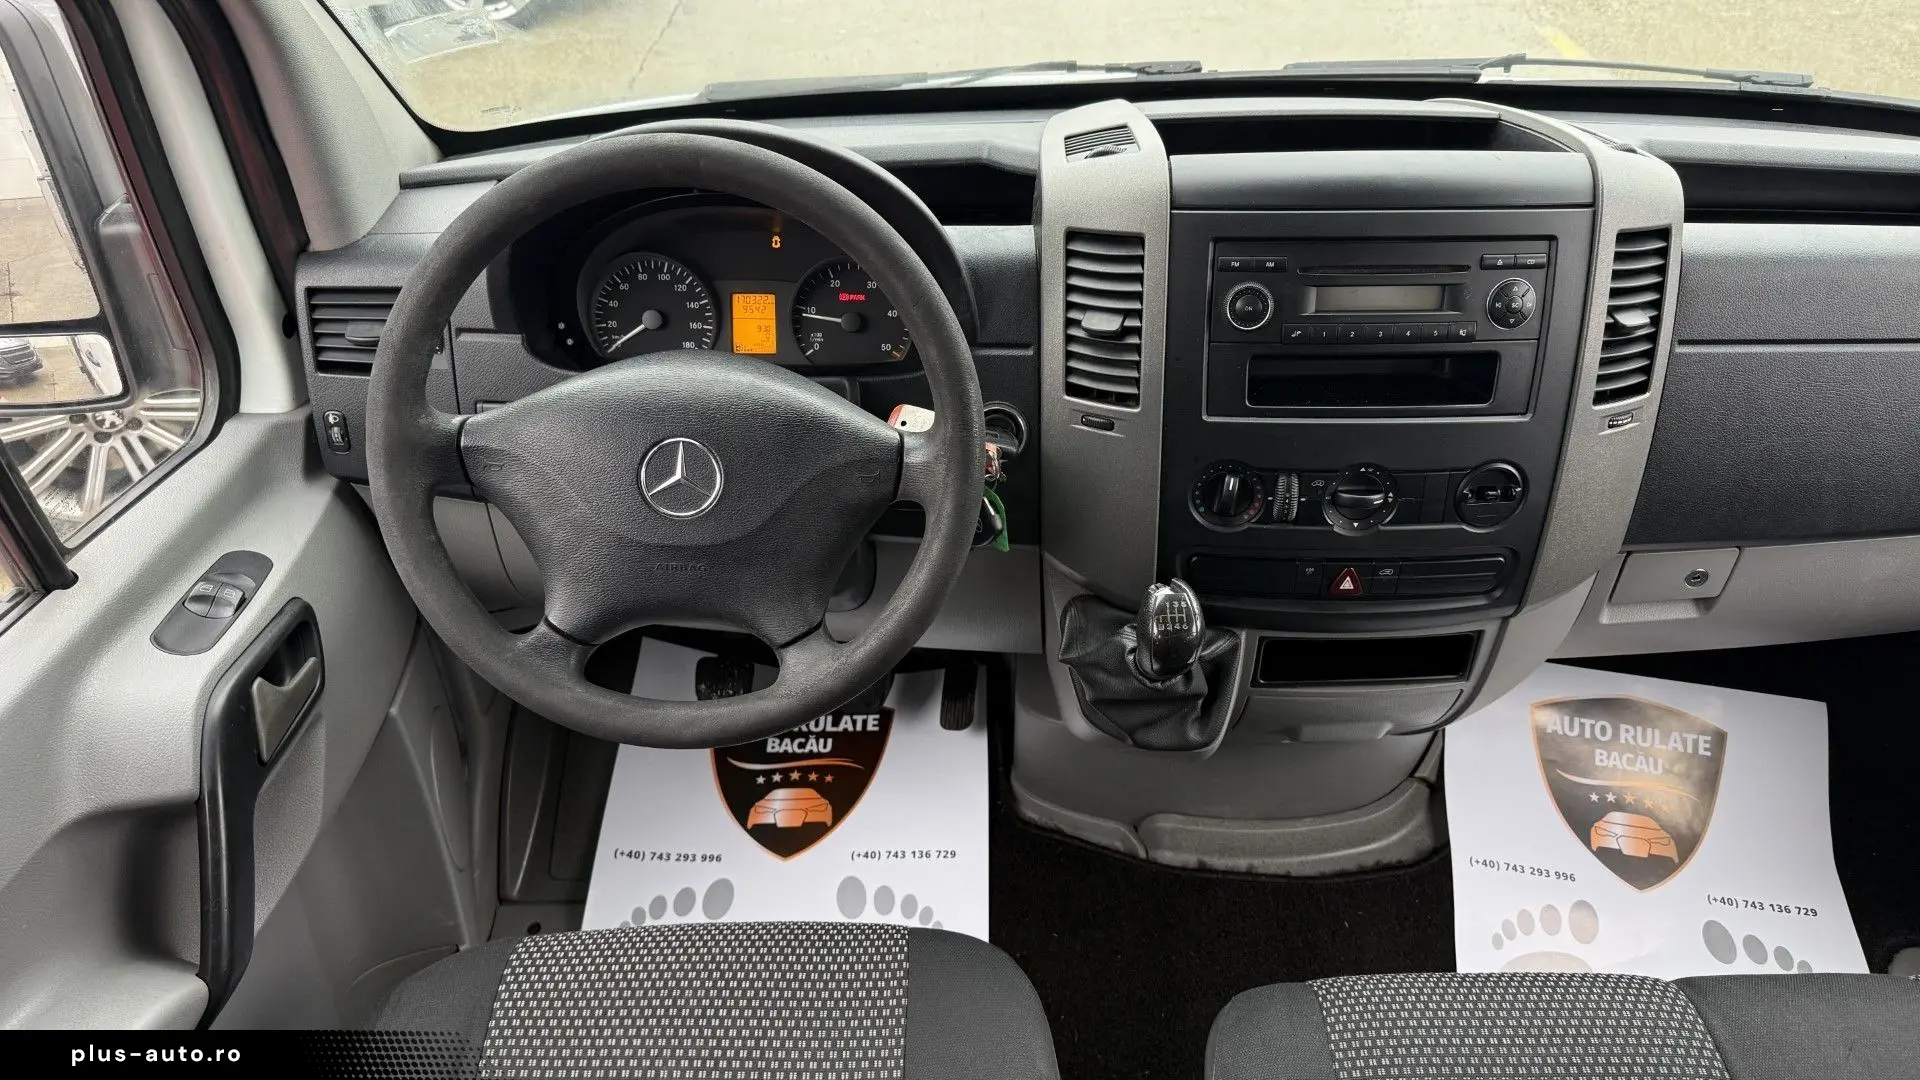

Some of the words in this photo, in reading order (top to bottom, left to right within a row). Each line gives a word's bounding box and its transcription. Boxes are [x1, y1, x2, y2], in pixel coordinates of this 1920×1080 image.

[638, 273, 648, 281] 80
[657, 273, 671, 281] 100
[619, 283, 630, 291] 60
[674, 284, 688, 292] 120
[830, 280, 841, 288] 20
[866, 281, 877, 289] 30
[608, 300, 619, 308] 40
[736, 295, 769, 305] 170322
[686, 301, 700, 309] 140
[806, 306, 816, 314] 10
[887, 310, 898, 318] 40
[607, 320, 618, 328] 20
[682, 341, 696, 349] 180
[881, 343, 892, 351] 50
[654, 562, 708, 572] AIRBAG
[1546, 713, 1613, 742] AUTO
[1619, 723, 1712, 757] RULATE
[766, 735, 833, 753] BACĂU
[1594, 748, 1663, 775] BACĂU
[614, 848, 646, 861] (+40)
[650, 851, 671, 861] 743
[675, 853, 697, 862] 293
[701, 853, 722, 862] 996
[851, 850, 881, 861] (+40)
[885, 850, 906, 859] 743
[911, 850, 931, 859] 136
[935, 850, 957, 859] 729
[1469, 856, 1500, 871] (+40)
[1503, 862, 1525, 874] 743
[1529, 866, 1551, 878] 293
[1554, 871, 1576, 882] 996
[1707, 894, 1739, 909] (+40)
[1742, 899, 1765, 911] 743
[1769, 903, 1791, 914] 136
[1794, 906, 1818, 917] 729
